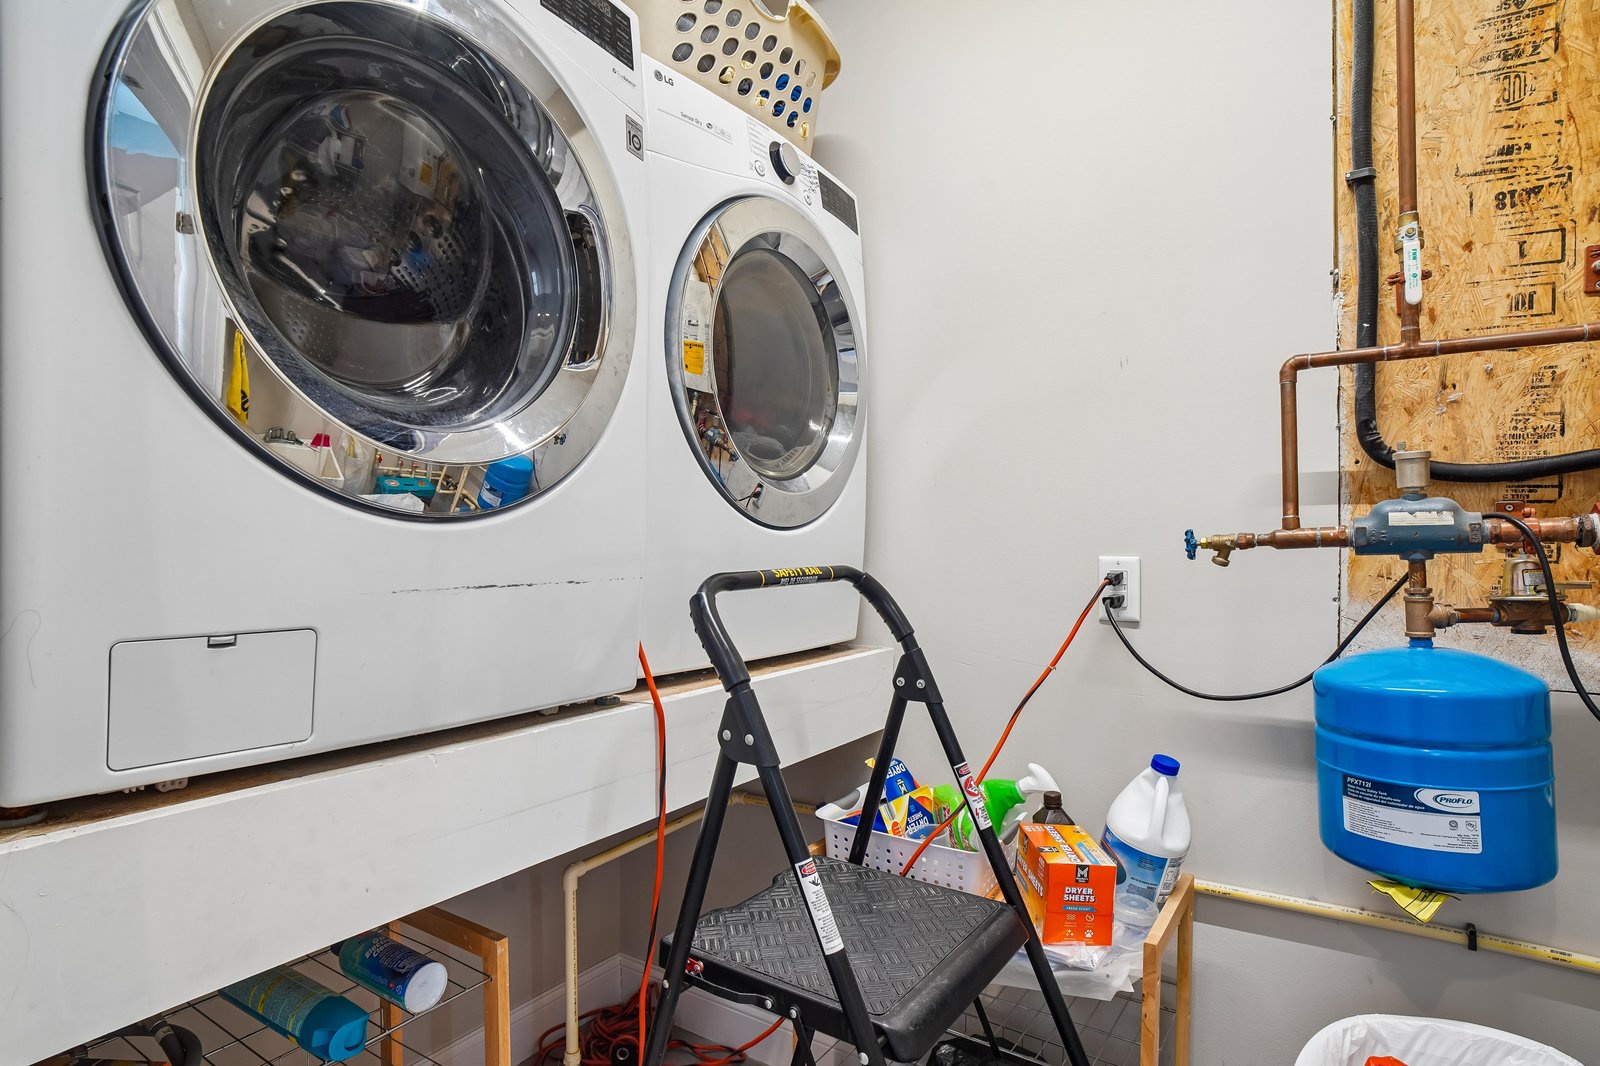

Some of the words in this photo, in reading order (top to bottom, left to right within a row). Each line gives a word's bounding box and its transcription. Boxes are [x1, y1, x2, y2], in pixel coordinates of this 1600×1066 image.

[663, 74, 675, 87] LG
[680, 111, 695, 123] Sensor
[694, 118, 703, 127] Dry
[772, 567, 802, 577] SAFETY
[803, 566, 822, 576] RAIL
[1065, 886, 1093, 895] DRYER
[1063, 894, 1095, 902] SHEETS
